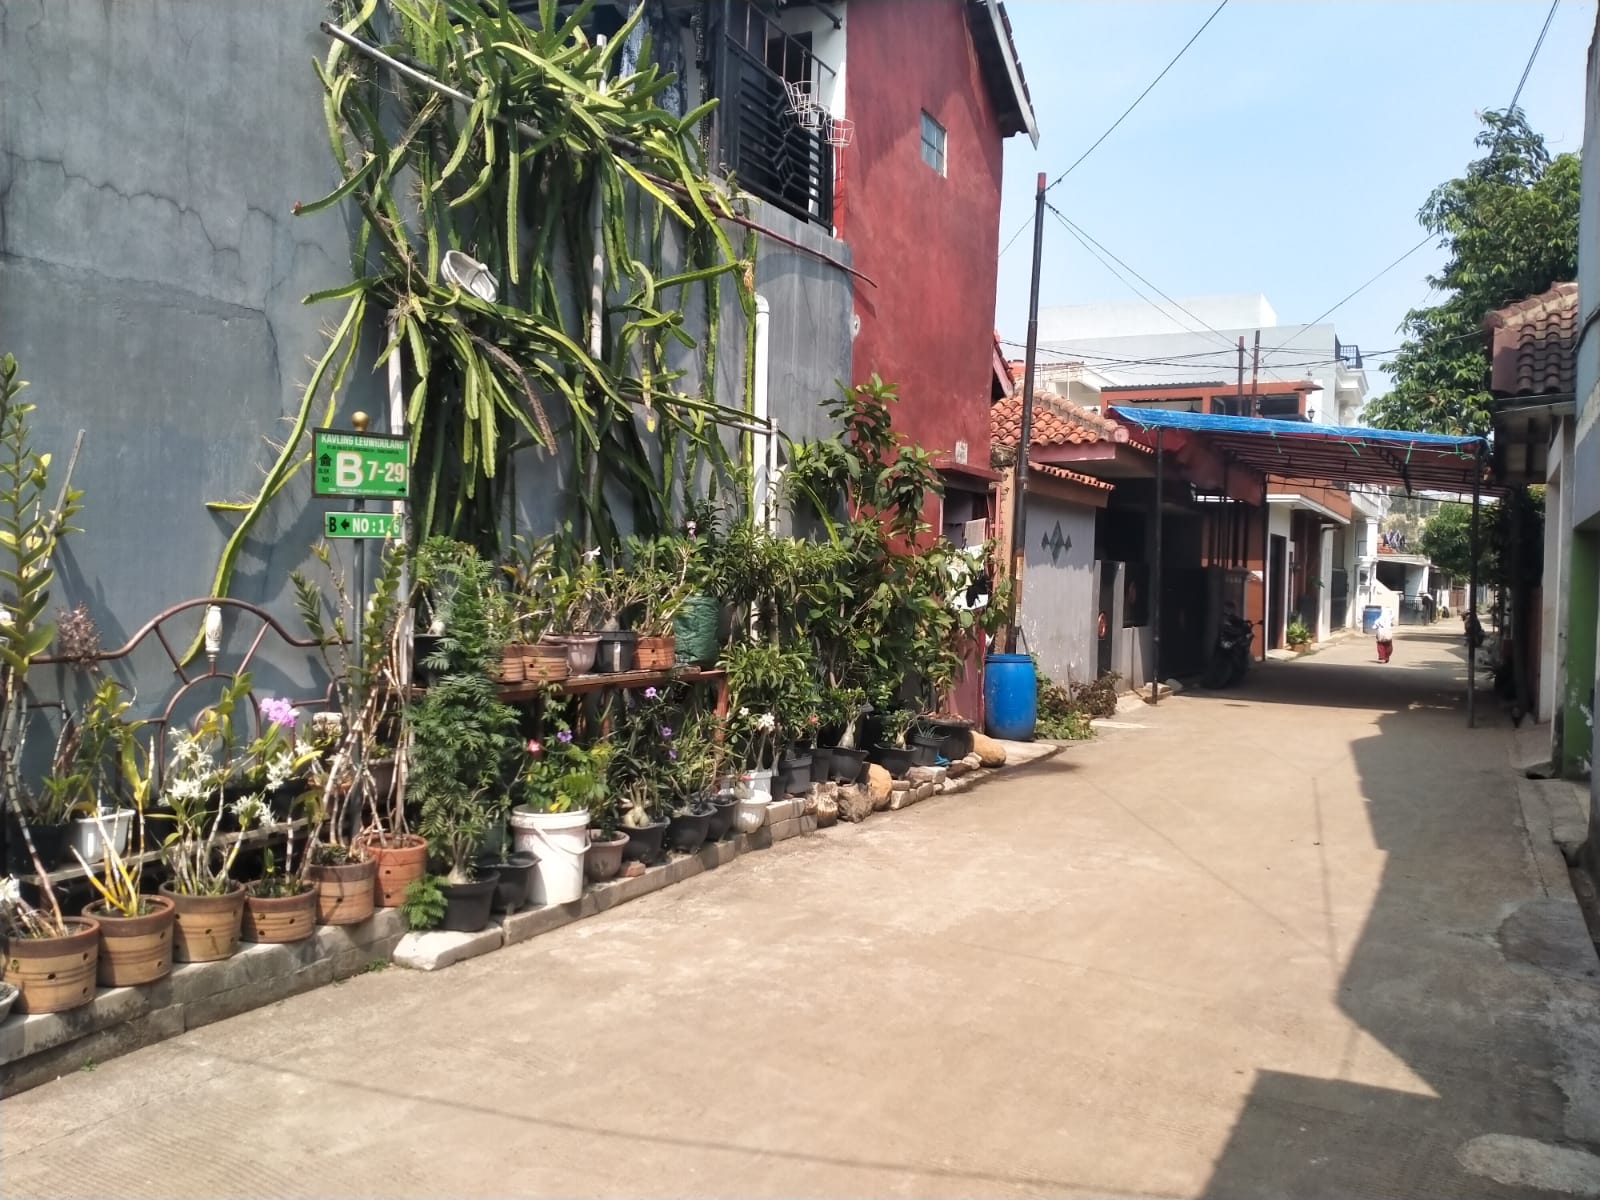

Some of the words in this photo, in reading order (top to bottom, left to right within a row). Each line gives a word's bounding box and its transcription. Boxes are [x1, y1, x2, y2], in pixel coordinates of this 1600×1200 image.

[321, 434, 353, 445] KAVLING
[337, 452, 363, 487] B
[367, 461, 405, 482] 7-29
[329, 517, 337, 532] B
